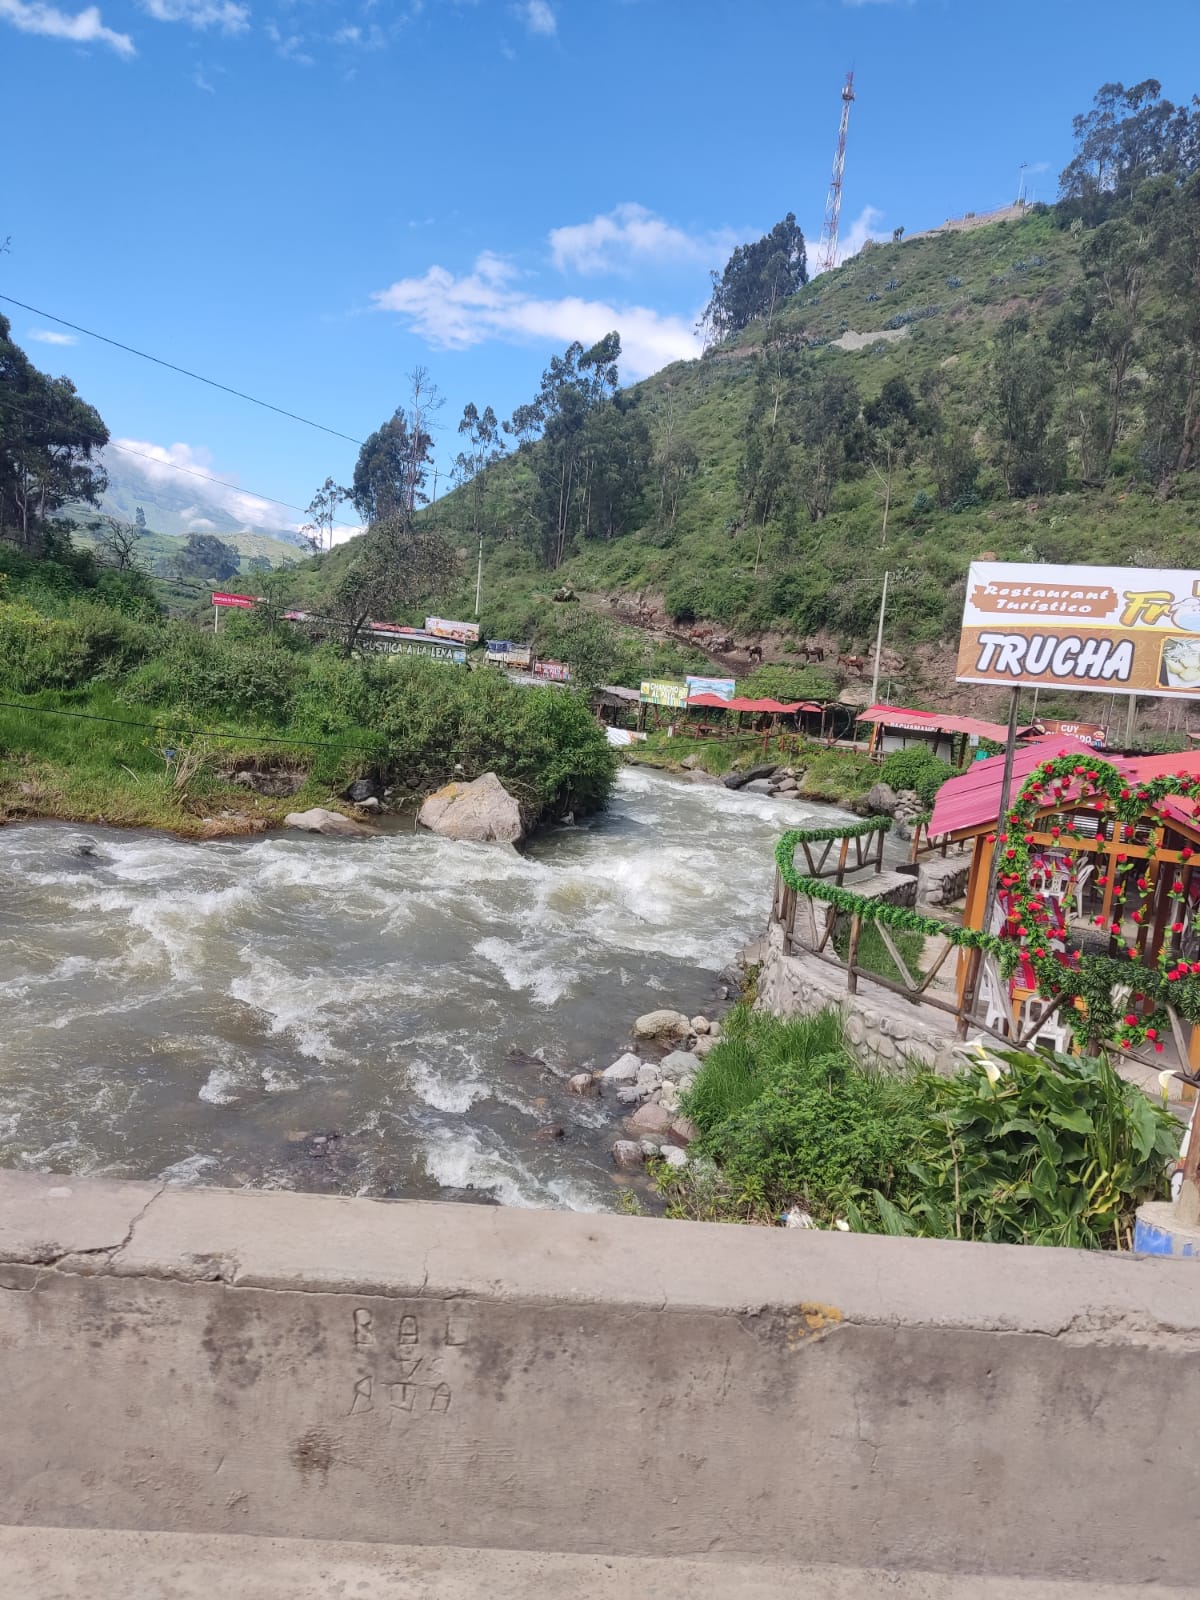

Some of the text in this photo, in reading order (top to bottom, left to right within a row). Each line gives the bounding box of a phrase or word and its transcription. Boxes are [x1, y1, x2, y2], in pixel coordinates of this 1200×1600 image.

[985, 585, 1109, 600] Restaurant
[996, 599, 1092, 613] Turístico
[406, 645, 413, 655] A
[976, 632, 1135, 681] TRUCHA
[650, 682, 679, 694] CHANCHO
[1060, 724, 1079, 733] CUY
